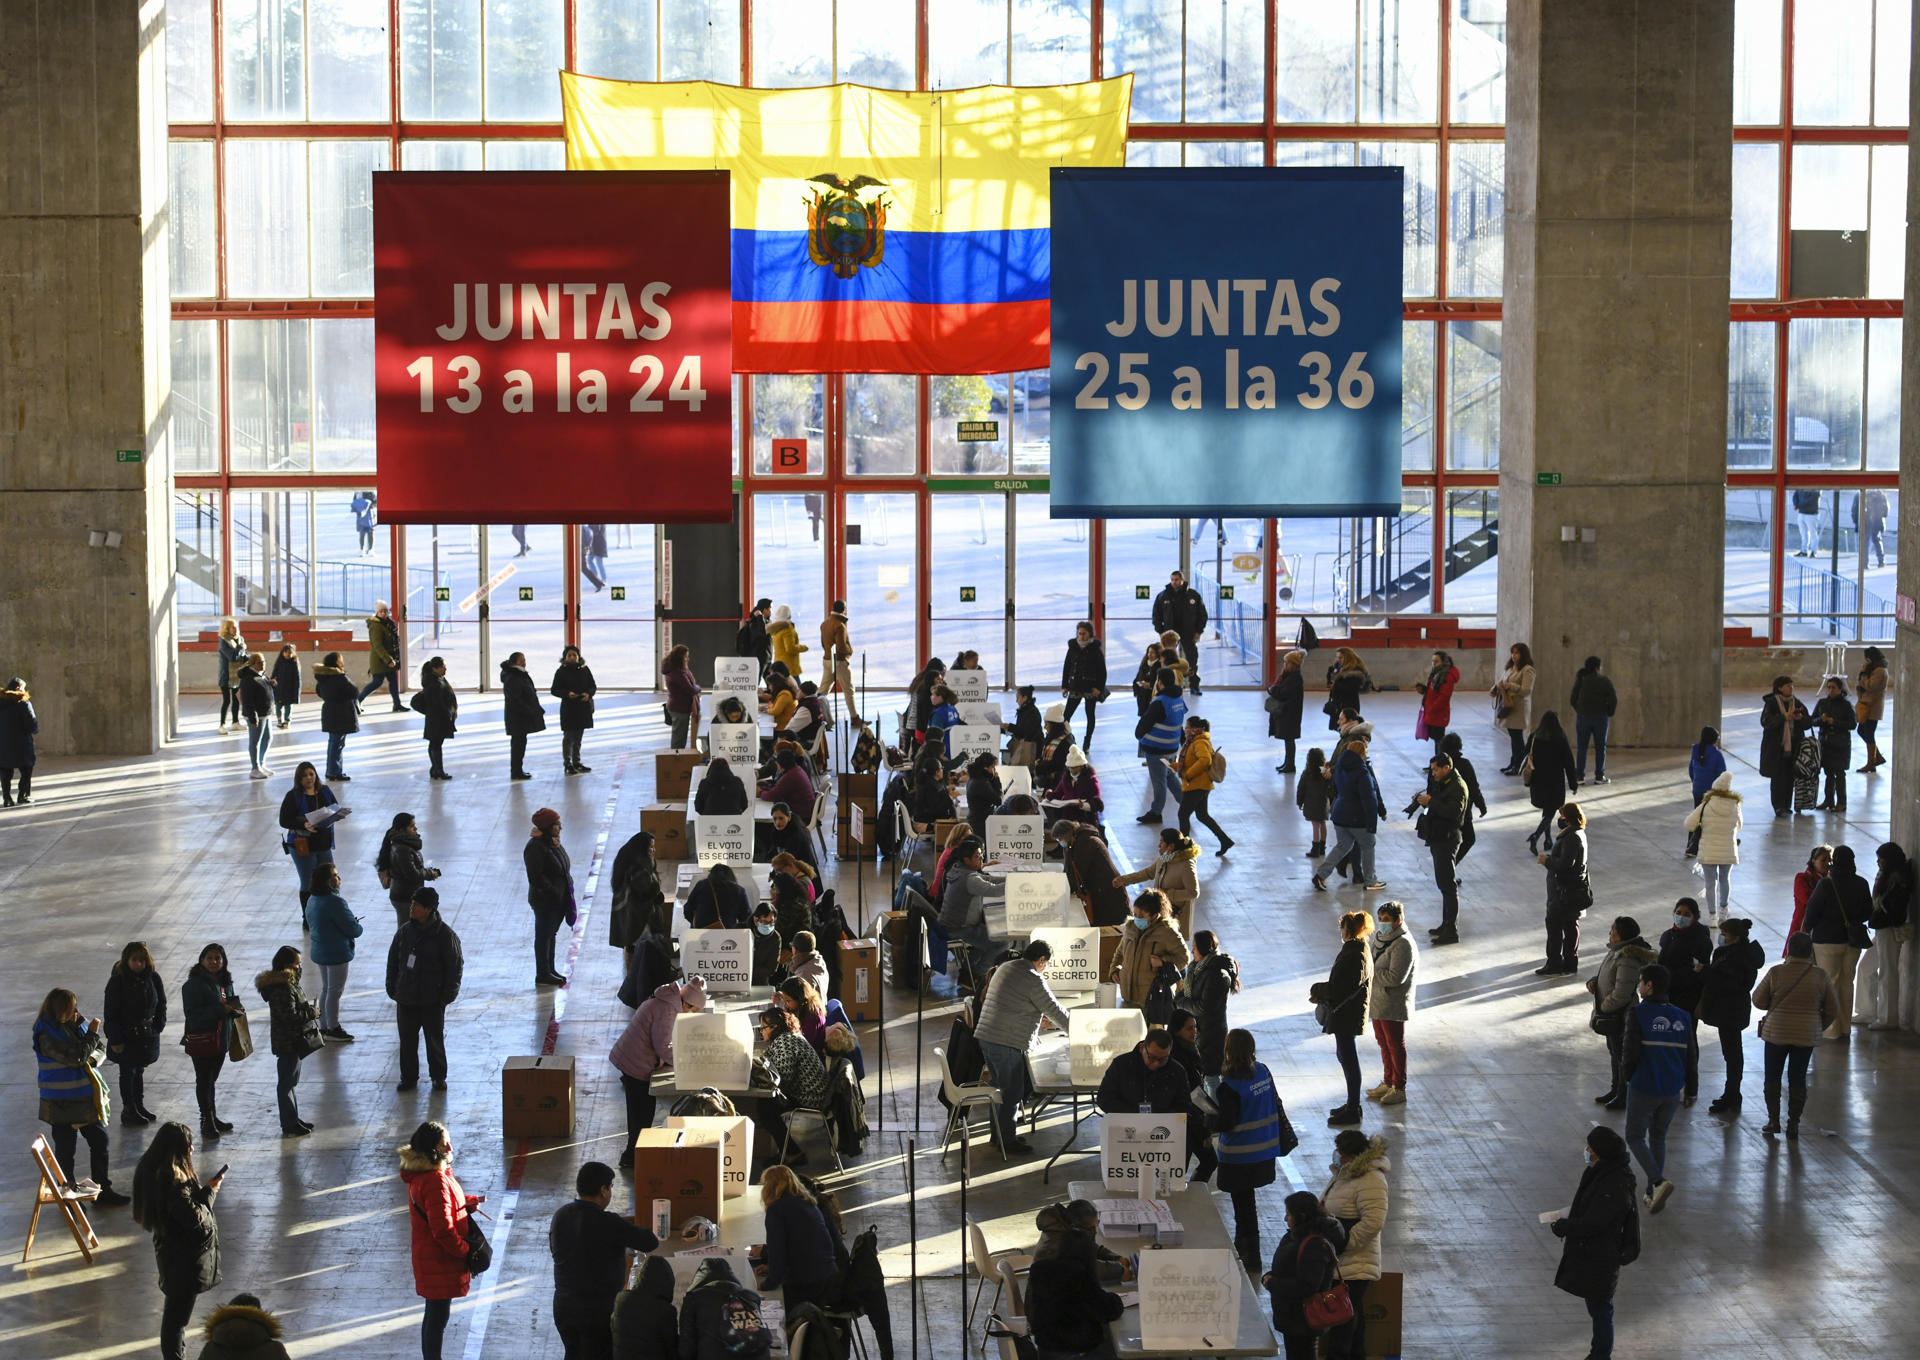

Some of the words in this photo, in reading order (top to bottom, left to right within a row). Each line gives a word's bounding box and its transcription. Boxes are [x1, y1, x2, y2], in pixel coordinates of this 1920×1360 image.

[435, 281, 672, 341] JUNTAS
[1105, 277, 1342, 338] JUNTAS
[406, 355, 483, 414] 13
[502, 369, 534, 414] a
[556, 352, 608, 414] la
[628, 354, 707, 413] 24
[1074, 351, 1151, 411] 25
[1170, 366, 1202, 411] a
[1225, 349, 1277, 411] la
[1296, 350, 1375, 410] 36
[961, 423, 984, 431] SALIDA
[986, 423, 995, 431] DE
[958, 432, 997, 440] EMERGENCIA
[780, 446, 800, 467] B
[994, 481, 1028, 489] SALIDA
[707, 841, 718, 850] EL
[718, 841, 742, 850] VOTO
[998, 841, 1009, 849] EL
[1010, 841, 1033, 850] VOTO
[698, 852, 710, 860] ES
[711, 852, 751, 860] SECRETO
[697, 960, 709, 969] EL
[711, 960, 738, 969] VOTO
[1060, 959, 1087, 968] VOTO
[702, 972, 749, 981] SECRETO
[1051, 971, 1098, 980] SECRETO
[1121, 1151, 1136, 1163] EL
[1138, 1151, 1171, 1163] VOTO
[1107, 1167, 1124, 1178] ES
